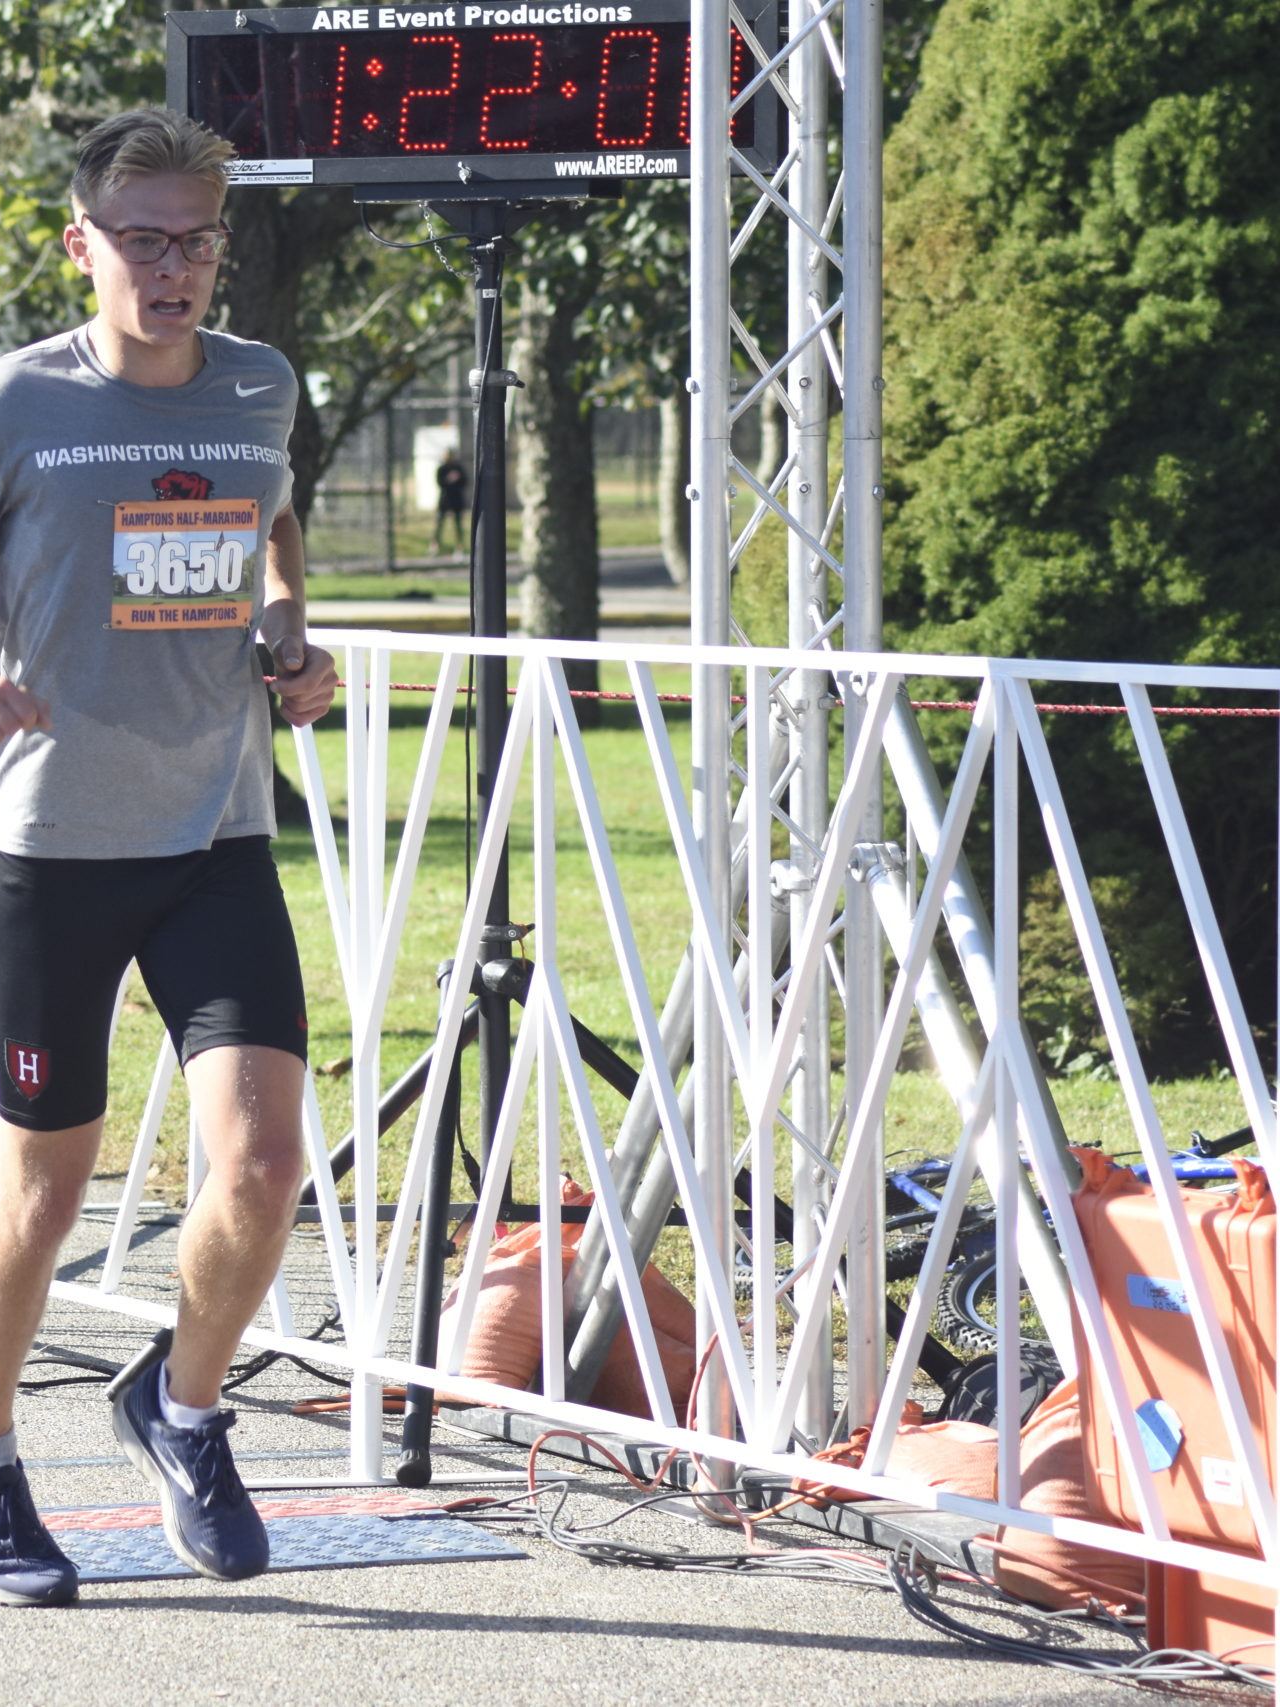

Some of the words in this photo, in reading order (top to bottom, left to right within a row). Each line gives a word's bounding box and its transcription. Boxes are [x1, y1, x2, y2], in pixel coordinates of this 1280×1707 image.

[312, 9, 369, 30] ARE
[378, 7, 456, 28] Event
[464, 3, 632, 26] Productions
[554, 154, 678, 176] www.AREEP.com
[35, 444, 185, 469] WASHINGTON
[121, 512, 174, 527] HAMPTONS
[176, 511, 253, 526] HALF-MARATHON
[126, 540, 244, 595] 3650
[131, 609, 155, 623] RUN
[159, 608, 179, 622] THE
[182, 606, 237, 621] HAMPTONS
[18, 1050, 40, 1084] H
